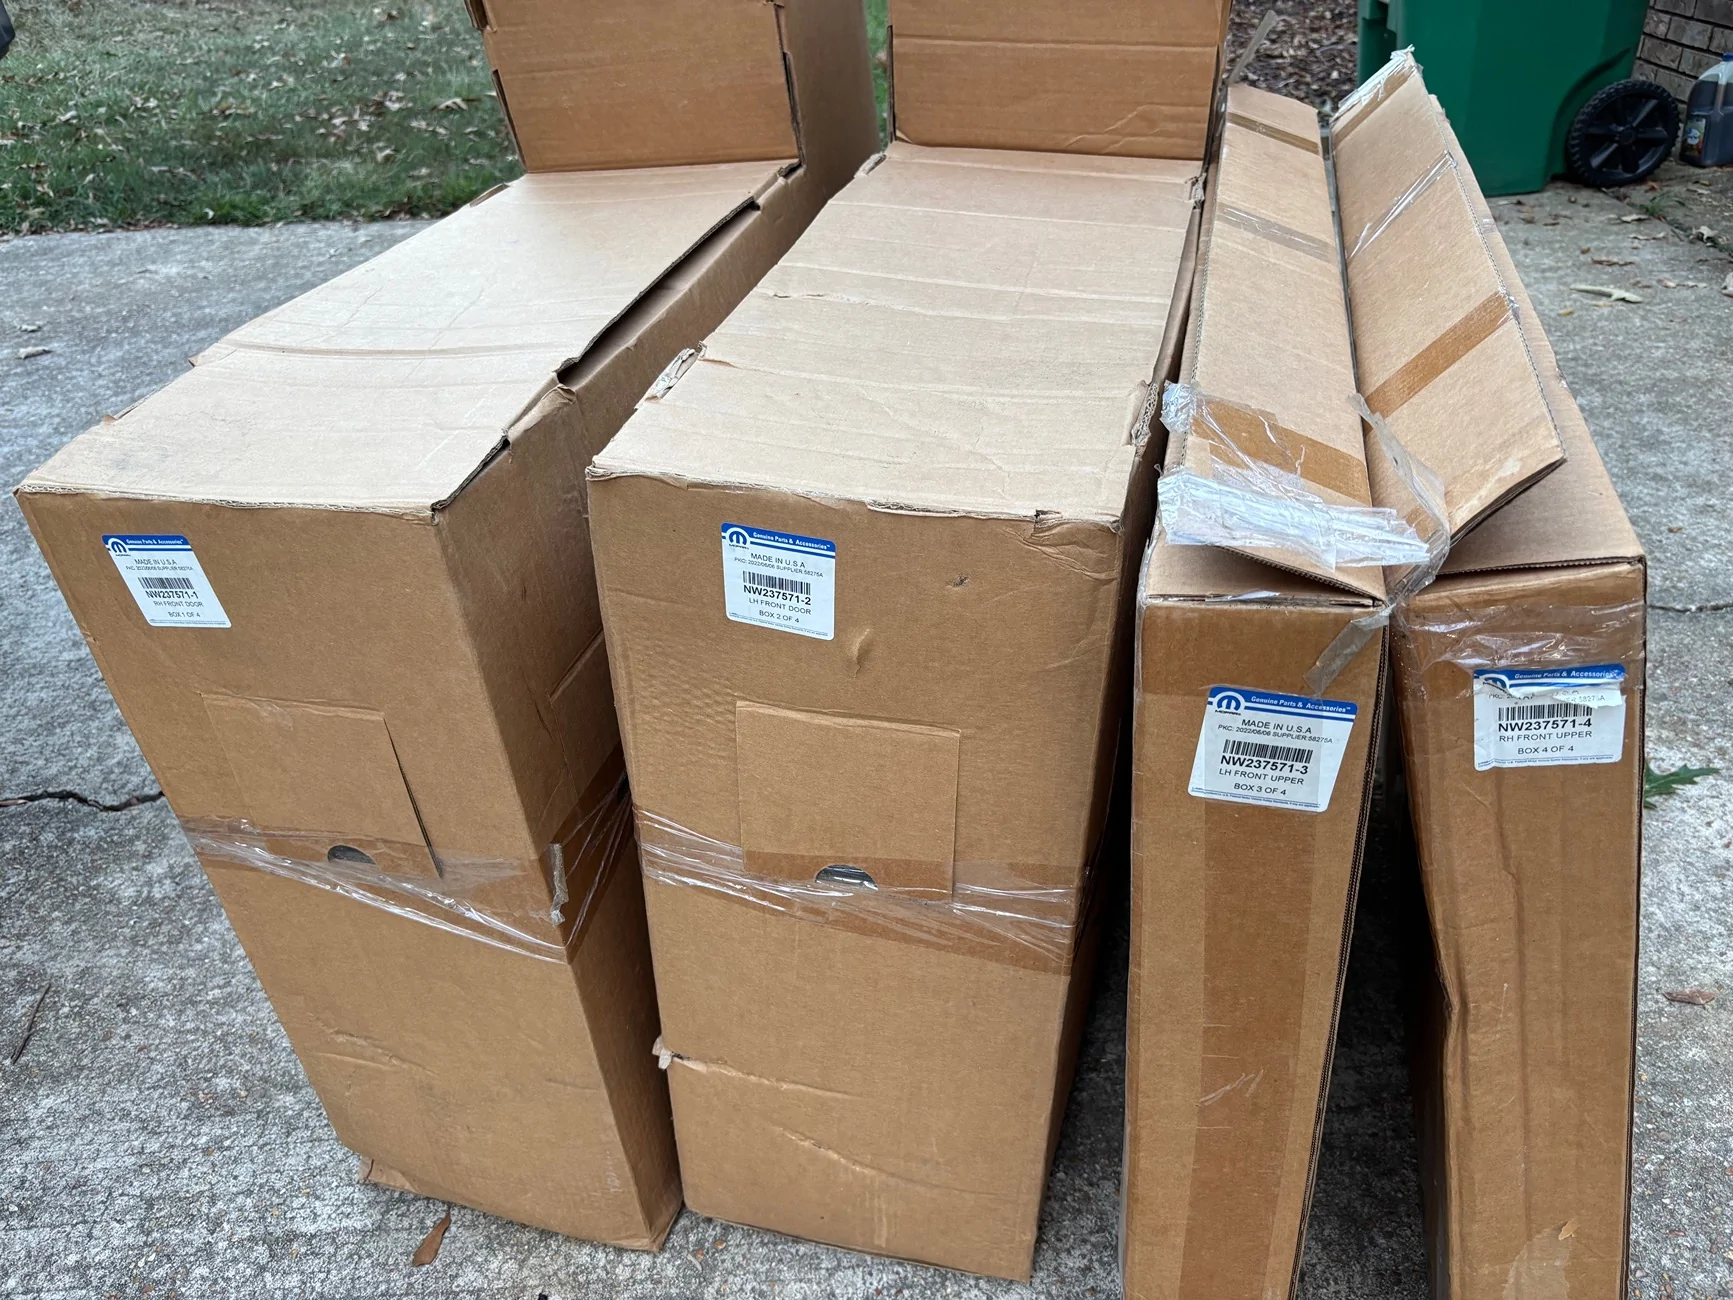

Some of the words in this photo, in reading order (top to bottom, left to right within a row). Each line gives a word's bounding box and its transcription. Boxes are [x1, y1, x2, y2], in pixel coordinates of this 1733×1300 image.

[753, 532, 774, 541] Genuine
[750, 552, 773, 562] MADE
[145, 590, 199, 599] NW237571-1
[744, 584, 812, 606] NW237571-2
[759, 610, 774, 618] BOX
[760, 600, 786, 610] FRONT
[788, 605, 812, 615] DOOR
[1251, 696, 1278, 706] Genuine
[1278, 699, 1296, 708] Parts
[1242, 719, 1271, 730] MADE
[1273, 723, 1284, 731] IN
[1286, 725, 1312, 734] U.S.A
[1498, 718, 1592, 732] NW237571-4
[1516, 732, 1553, 742] FRONT
[1556, 730, 1592, 739] UPPER
[1220, 755, 1309, 775] NW237571-3
[1219, 768, 1232, 776] LH
[1234, 770, 1269, 781] FRONT
[1270, 774, 1304, 785] UPPER
[1234, 782, 1254, 792] BOX
[1264, 786, 1278, 795] OF
